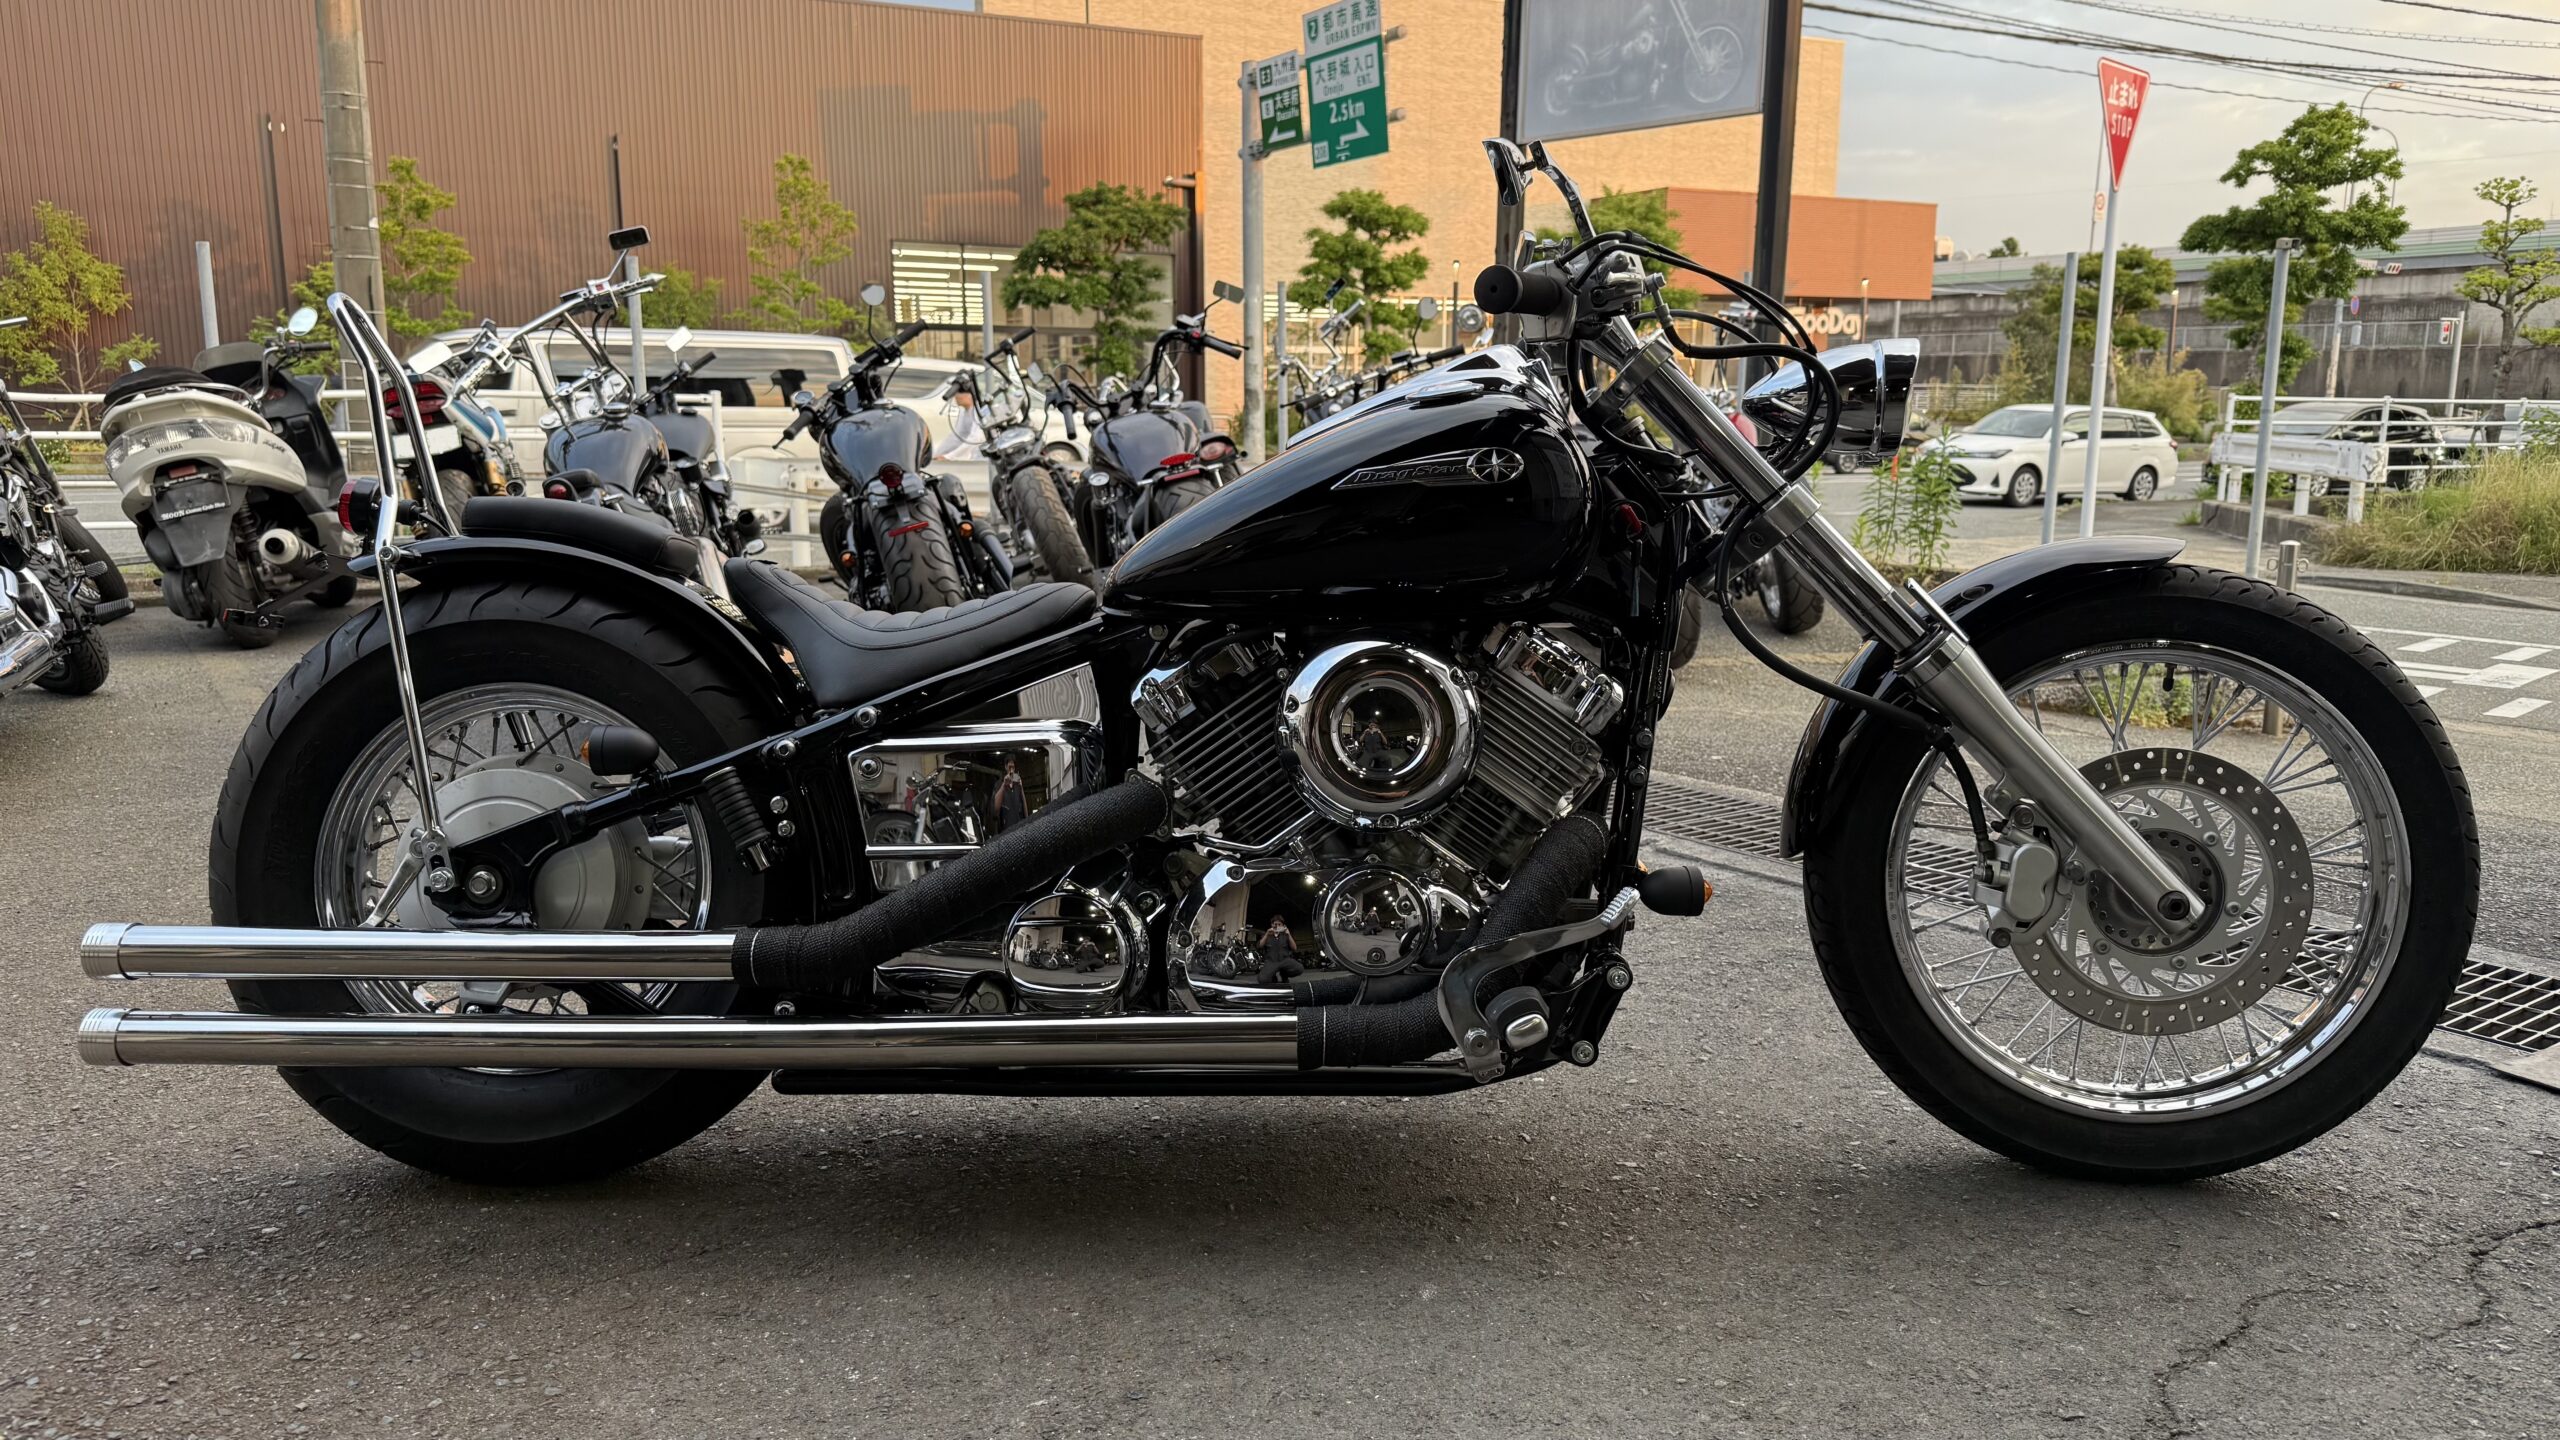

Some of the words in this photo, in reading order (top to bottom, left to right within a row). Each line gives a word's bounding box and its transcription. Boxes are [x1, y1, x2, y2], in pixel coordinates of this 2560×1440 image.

[2107, 76, 2139, 110] 止まれ
[1329, 99, 1366, 124] 2.5km
[2110, 112, 2133, 139] STOP
[157, 443, 184, 454] YAMAHA
